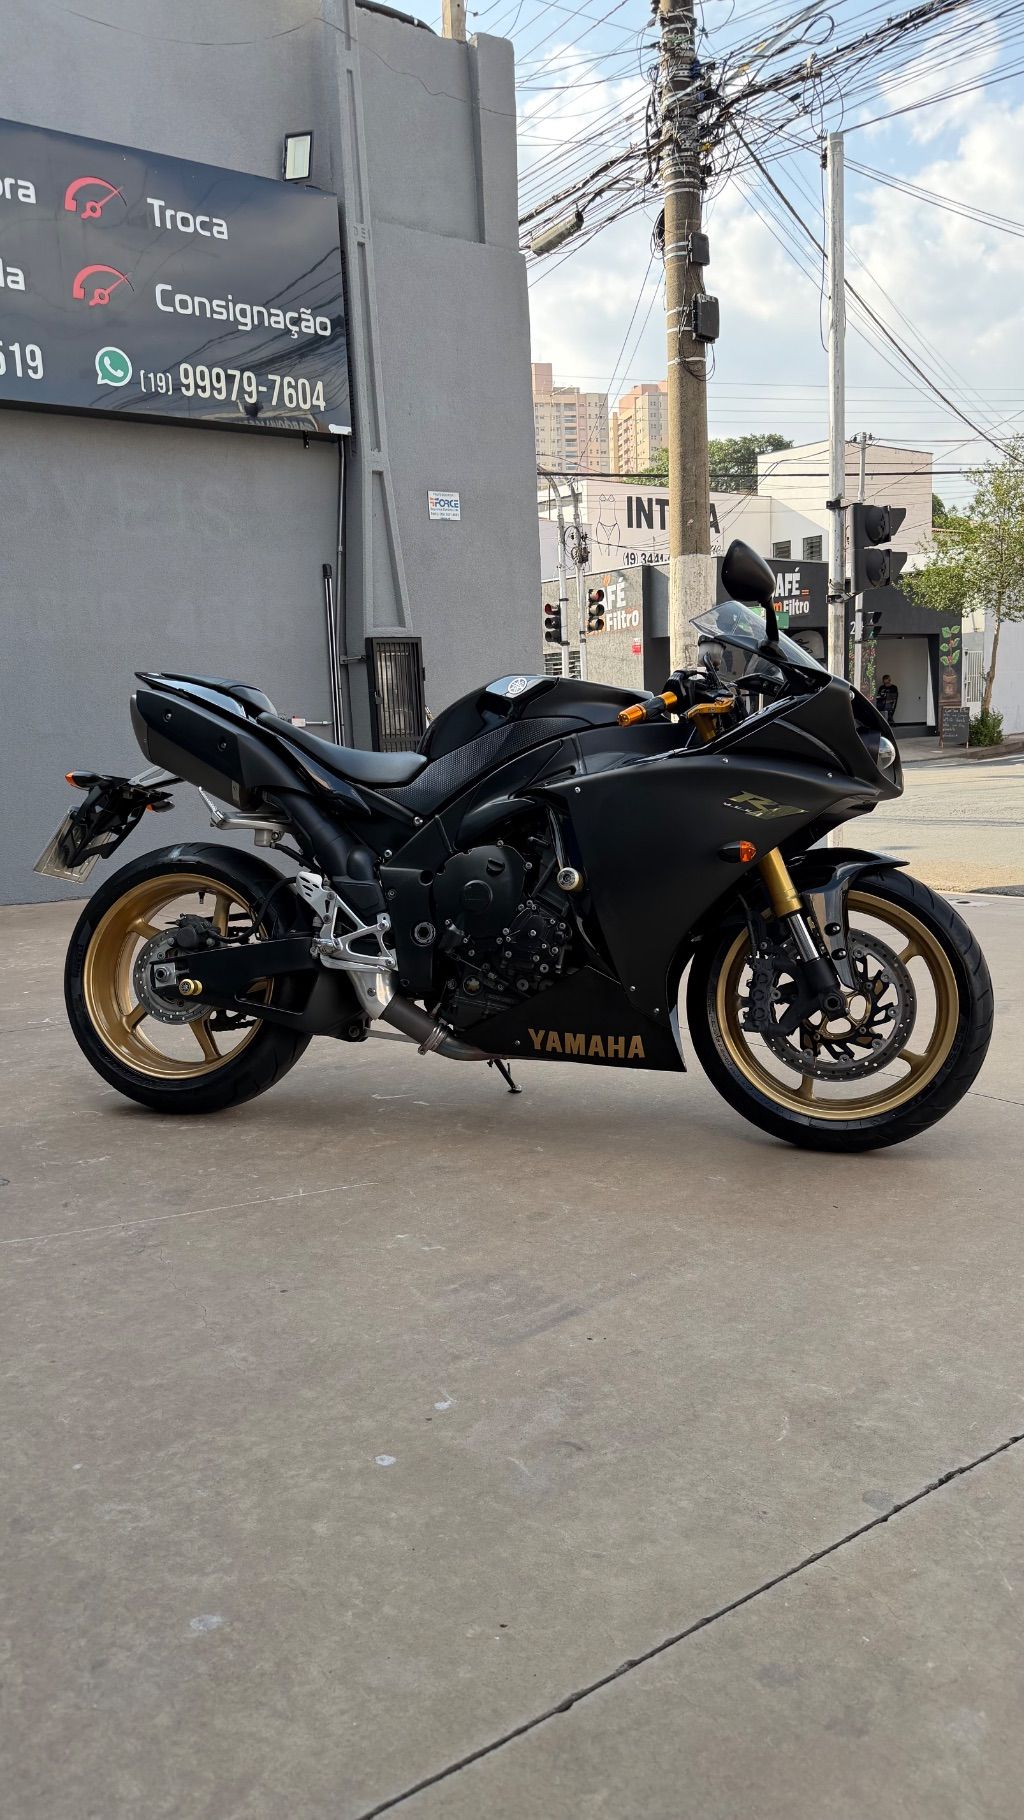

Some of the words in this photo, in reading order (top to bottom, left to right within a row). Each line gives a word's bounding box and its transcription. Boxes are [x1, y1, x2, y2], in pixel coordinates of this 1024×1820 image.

[146, 197, 229, 241] Troca
[155, 283, 332, 339] Consignação
[179, 362, 326, 412] 99979-7604
[771, 567, 801, 597] AFÉ
[605, 609, 640, 632] Filtro
[783, 599, 810, 616] Filtro
[527, 1028, 646, 1059] YAMAHA
